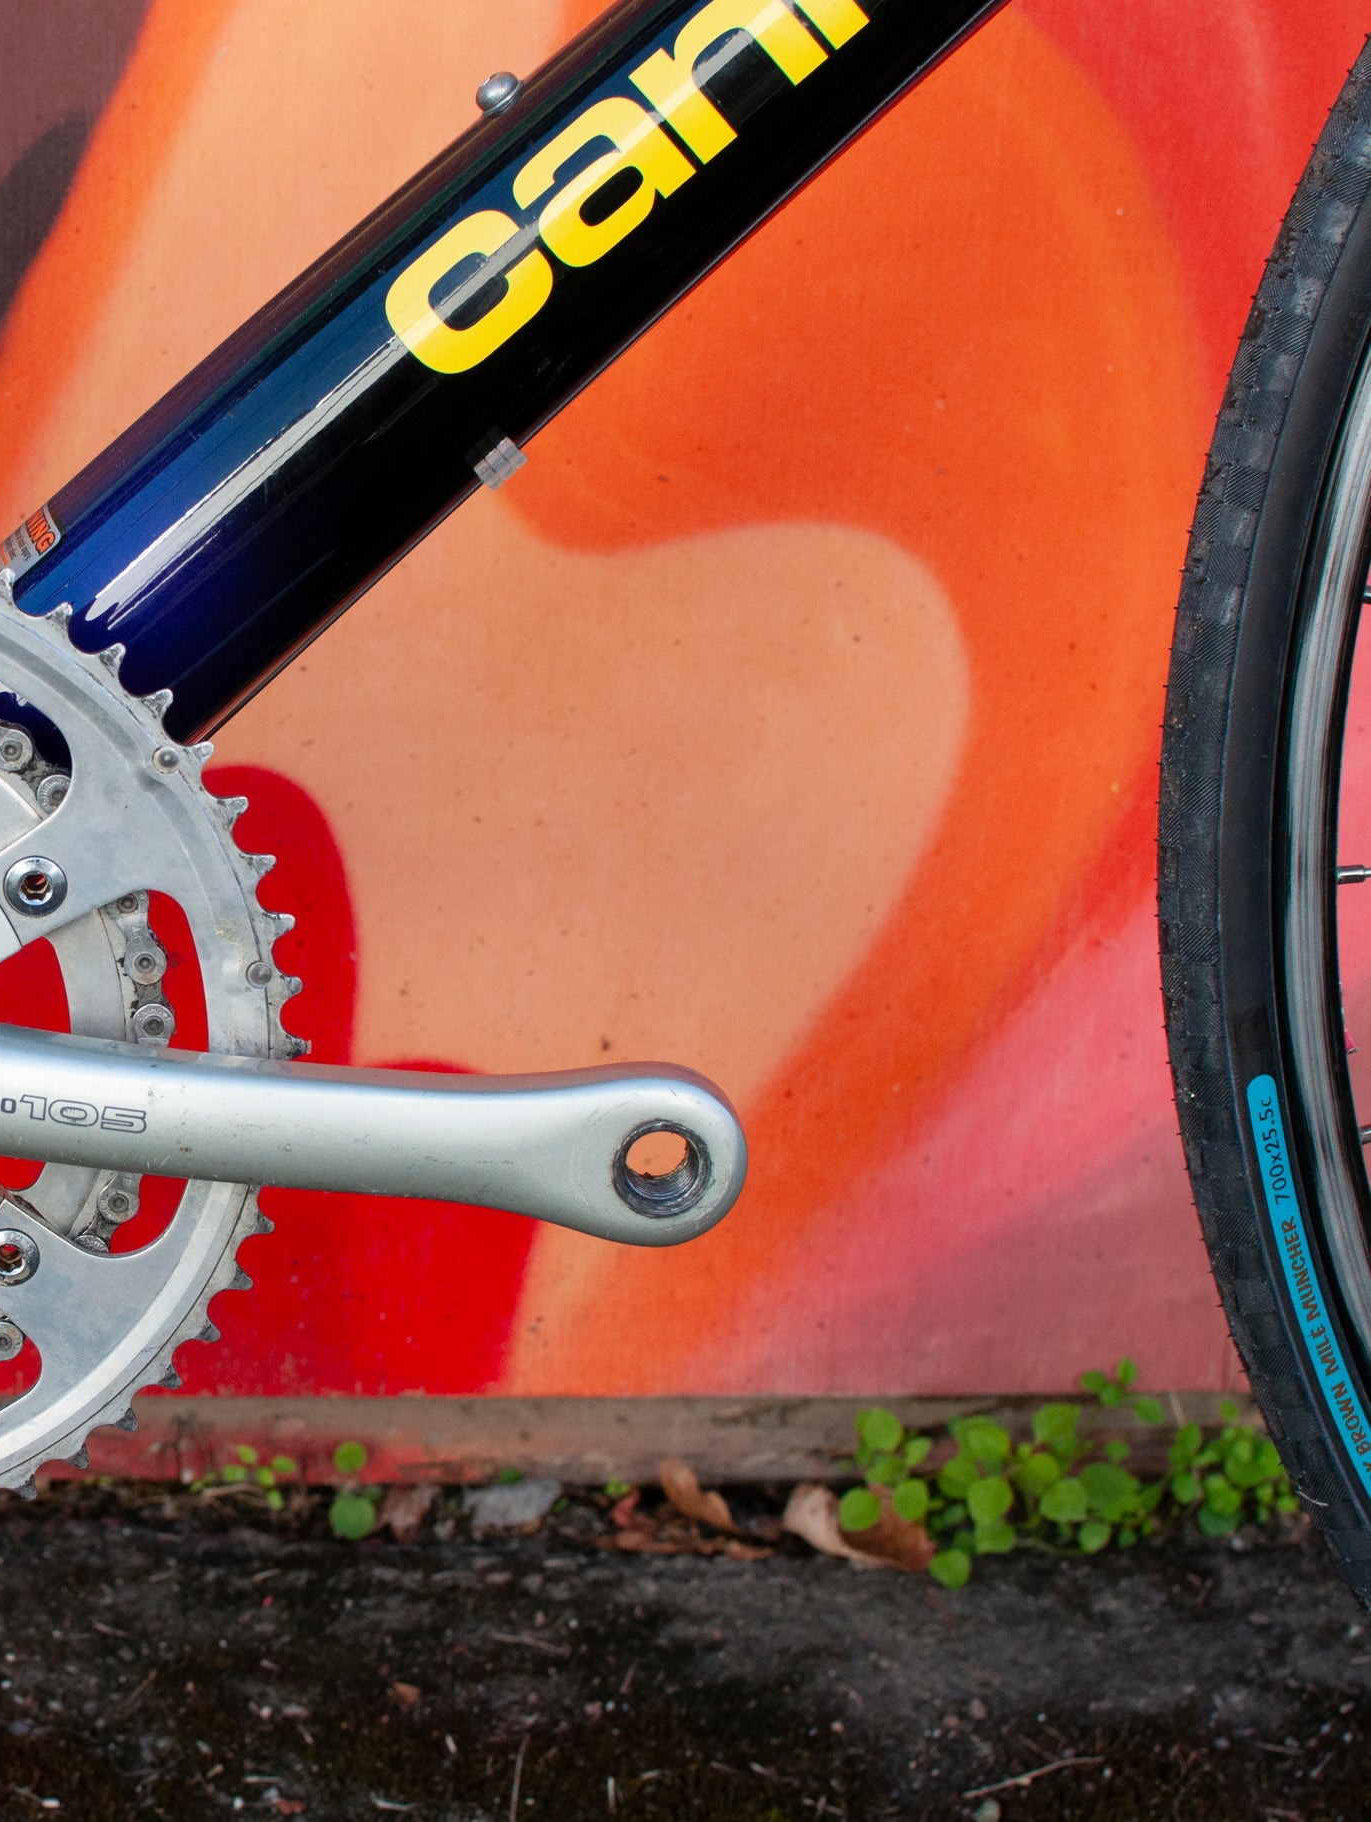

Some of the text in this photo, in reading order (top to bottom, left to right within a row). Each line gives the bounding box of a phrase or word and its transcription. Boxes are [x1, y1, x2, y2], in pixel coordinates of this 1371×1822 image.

[20, 1094, 147, 1134] 105
[1280, 1215, 1321, 1322] MUNCHER
[1311, 1322, 1339, 1377] MILE
[1331, 1381, 1371, 1456] BROWN
